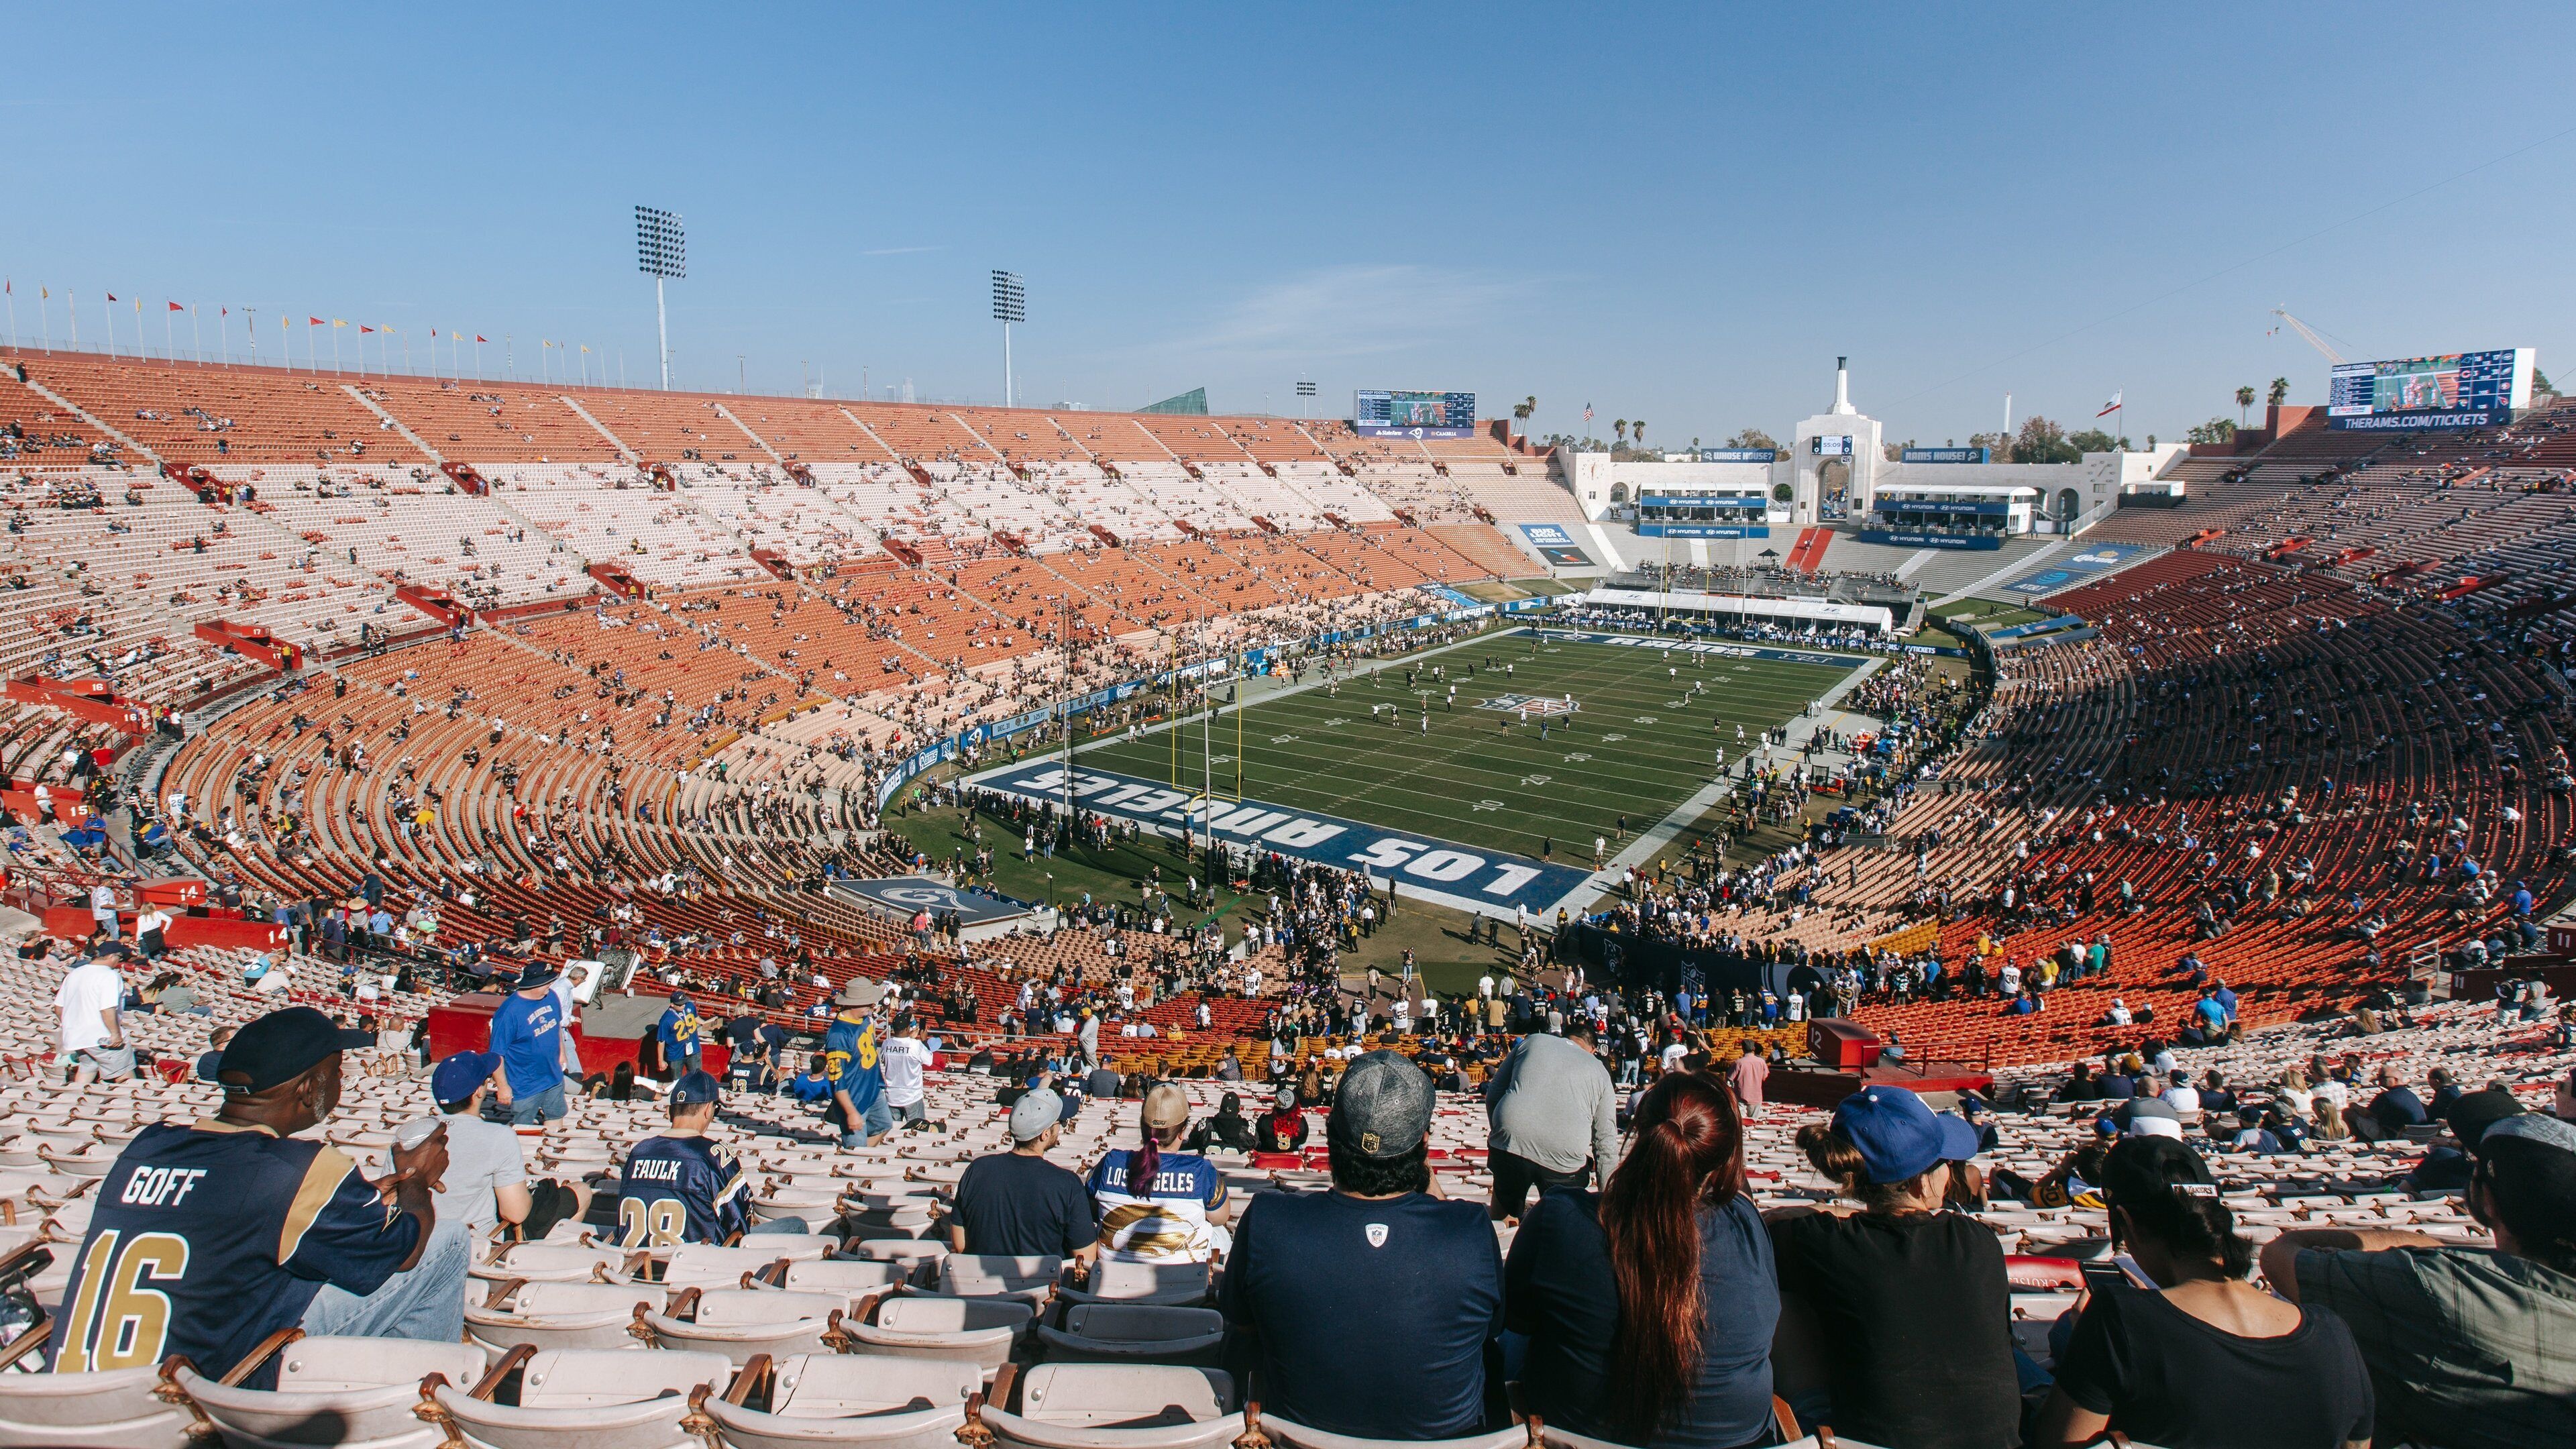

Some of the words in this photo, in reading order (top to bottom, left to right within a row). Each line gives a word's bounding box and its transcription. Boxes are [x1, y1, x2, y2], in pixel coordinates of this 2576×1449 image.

[2345, 413, 2489, 429] THERAMS.COM/TICKETS
[1713, 451, 1741, 460] WHOSE
[1742, 451, 1774, 460] HOUSE?
[1905, 451, 1932, 460] RAMS
[1933, 451, 1966, 460] HOUSE!
[2072, 554, 2118, 564] Corona
[2014, 584, 2048, 592] AT&T
[1453, 610, 1462, 620] LOS
[1603, 637, 1761, 657] RAMS
[92, 683, 103, 691] 16
[124, 712, 137, 722] 16
[998, 724, 1006, 732] DEC.
[1271, 734, 1300, 743] 20
[1602, 733, 1627, 741] 40
[1210, 753, 1239, 764] 10
[1564, 752, 1593, 762] 30
[1521, 774, 1552, 786] 20
[171, 799, 183, 808] 29
[1012, 769, 1348, 848] ANGELES
[1472, 800, 1505, 811] 10
[70, 805, 88, 817] 15
[1346, 837, 1544, 897] LOS
[179, 885, 199, 902] 14
[268, 926, 288, 944] 14
[2557, 932, 2571, 949] 11
[2005, 974, 2017, 984] 30
[2454, 975, 2465, 989] 11
[1246, 981, 1254, 989] 30
[1699, 999, 1708, 1008] 29
[1764, 995, 1774, 1004] 99
[1646, 1001, 1654, 1012] 9
[1792, 1002, 1801, 1010] 30
[1397, 1010, 1408, 1020] 25
[533, 1018, 557, 1037] RAMS
[674, 1014, 697, 1042] 29
[1811, 1026, 1822, 1050] 12
[857, 1023, 877, 1070] 8
[885, 1045, 911, 1055] HART
[1668, 1050, 1684, 1058] GURLEY
[733, 1069, 750, 1077] WARNER
[732, 1079, 747, 1093] 13
[632, 1159, 681, 1181] FAULK
[1107, 1166, 1129, 1187] LOS
[121, 1165, 207, 1206] GOFF
[2188, 1185, 2212, 1195] LAKERS
[619, 1197, 687, 1248] 28
[54, 1229, 190, 1374] 16
